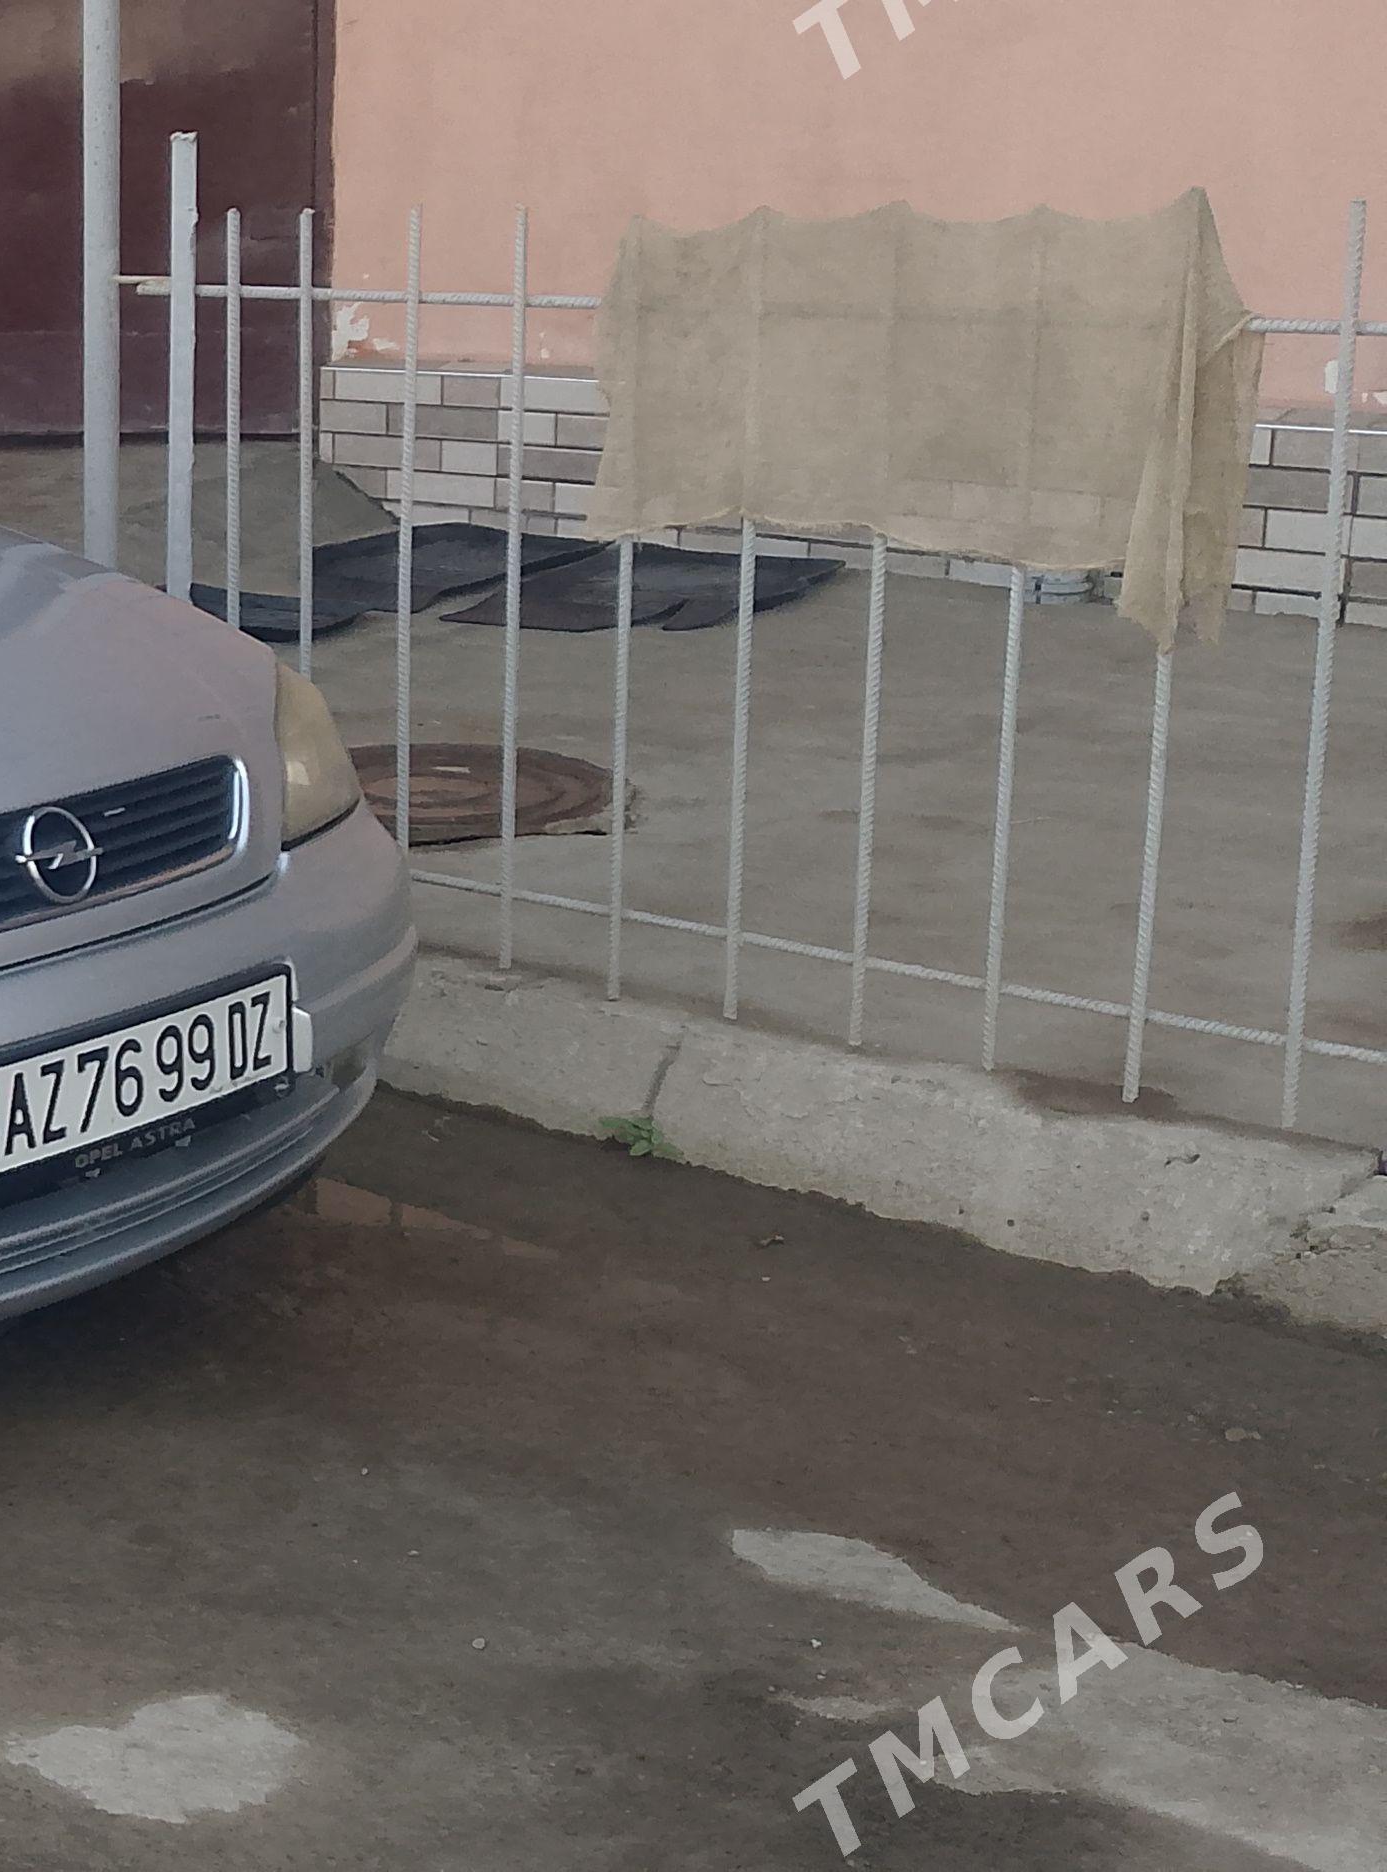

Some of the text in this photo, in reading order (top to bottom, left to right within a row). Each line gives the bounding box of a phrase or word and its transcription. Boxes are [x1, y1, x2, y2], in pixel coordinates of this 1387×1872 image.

[5, 991, 271, 1156] AZ 76 99 DZ
[75, 1118, 196, 1168] OPEL ASTRA
